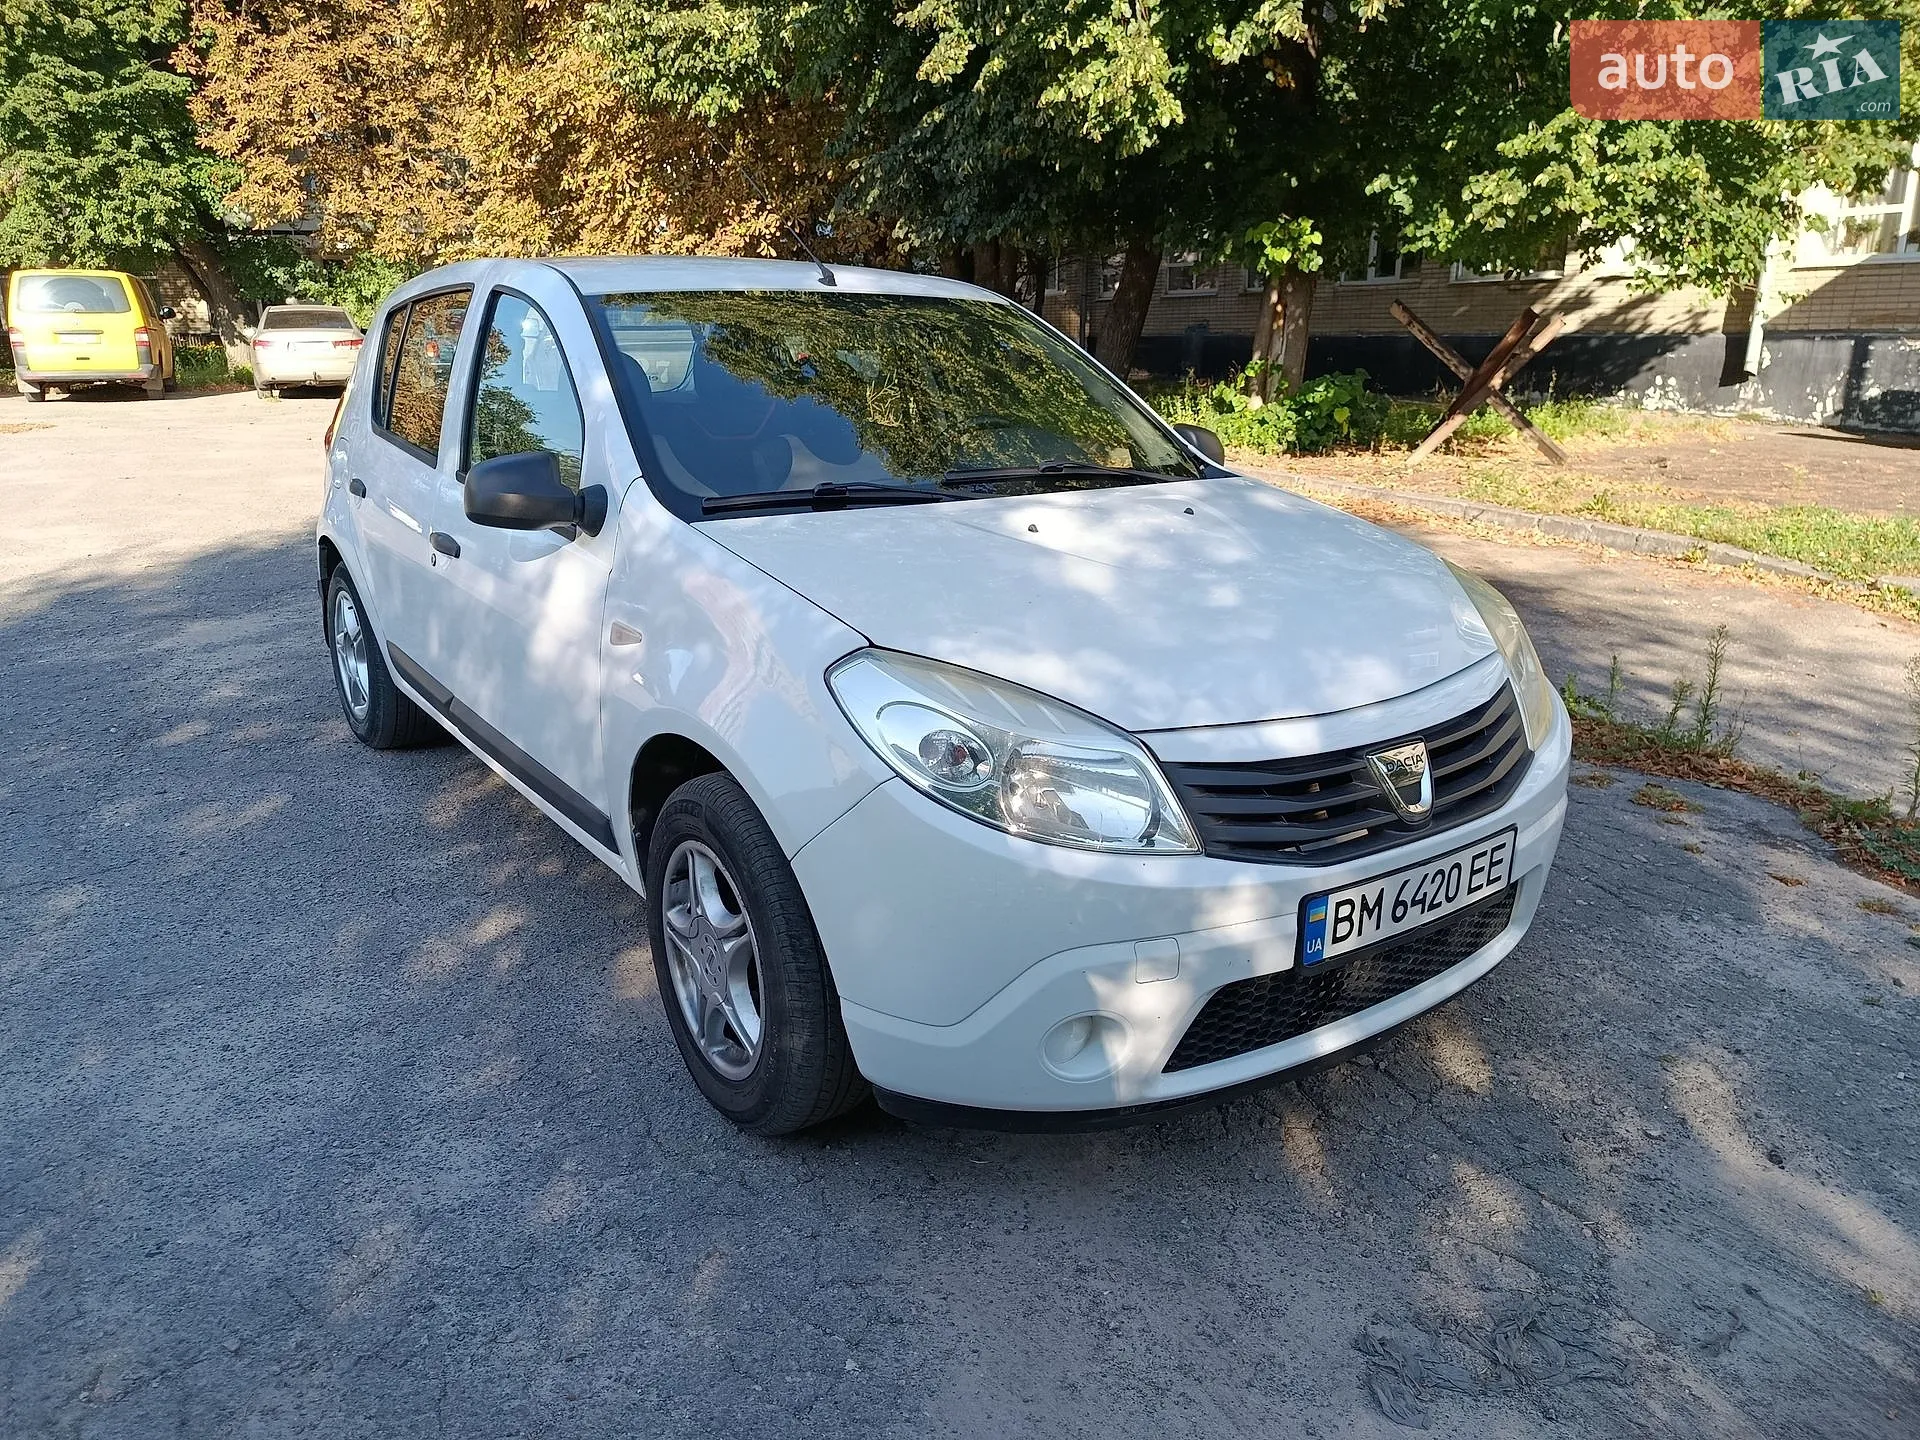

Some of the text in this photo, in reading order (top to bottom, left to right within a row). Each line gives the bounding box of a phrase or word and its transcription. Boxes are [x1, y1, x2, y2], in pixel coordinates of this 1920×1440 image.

[1386, 753, 1424, 772] DACIA
[1331, 841, 1507, 945] BM 6420 EE
[1305, 937, 1323, 954] UA
